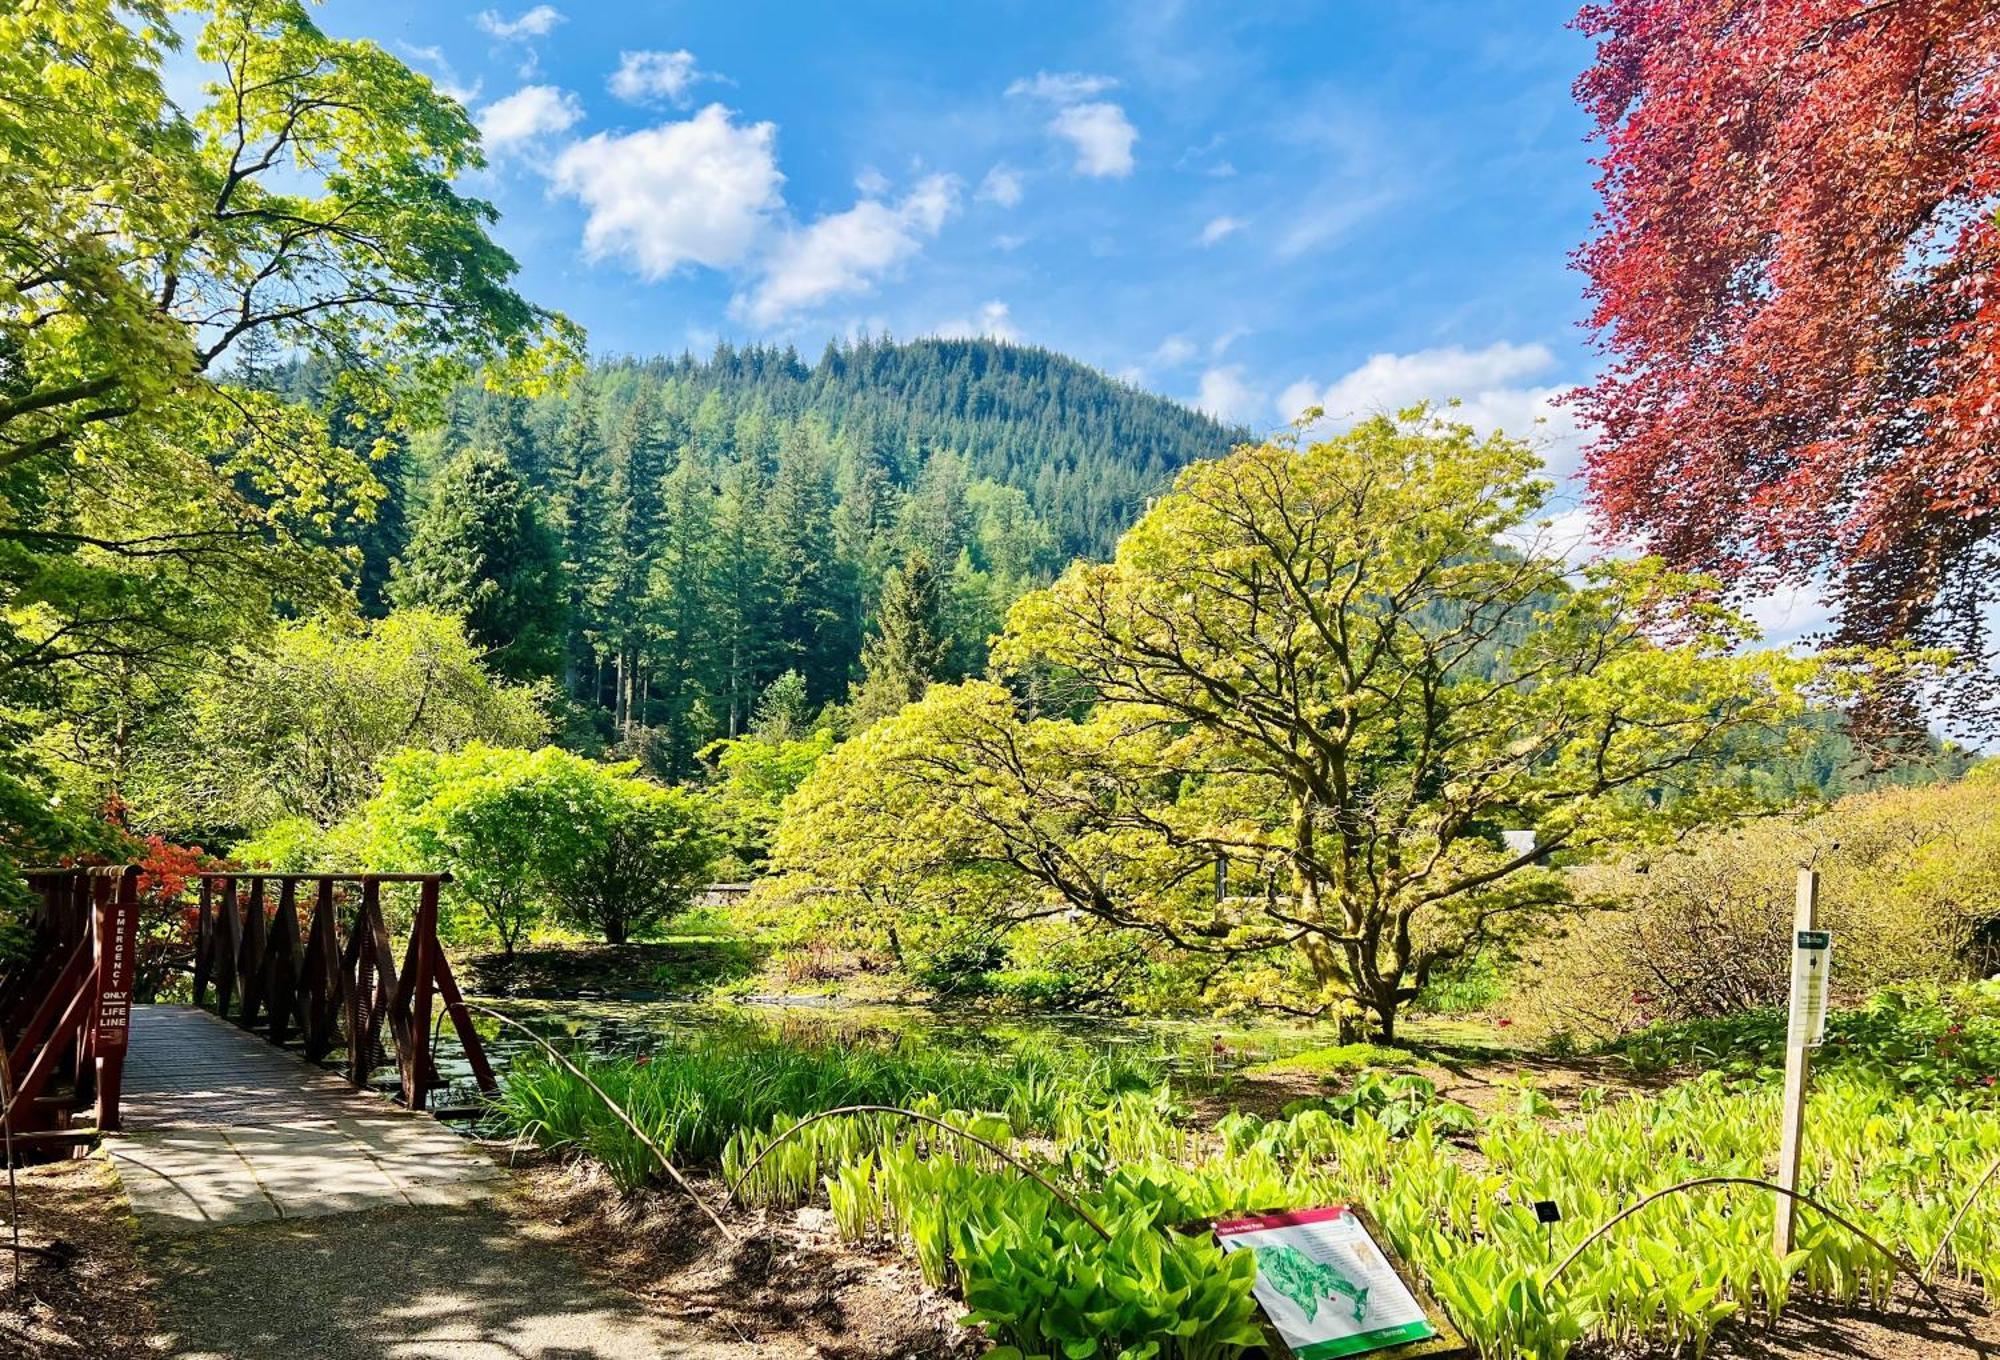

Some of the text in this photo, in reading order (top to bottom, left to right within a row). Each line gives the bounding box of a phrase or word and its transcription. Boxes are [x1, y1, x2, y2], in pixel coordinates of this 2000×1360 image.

[112, 910, 126, 988] EMERGENCY
[103, 991, 127, 1000] ONLY
[101, 1007, 126, 1016] LIFE
[100, 1018, 126, 1026] LINE
